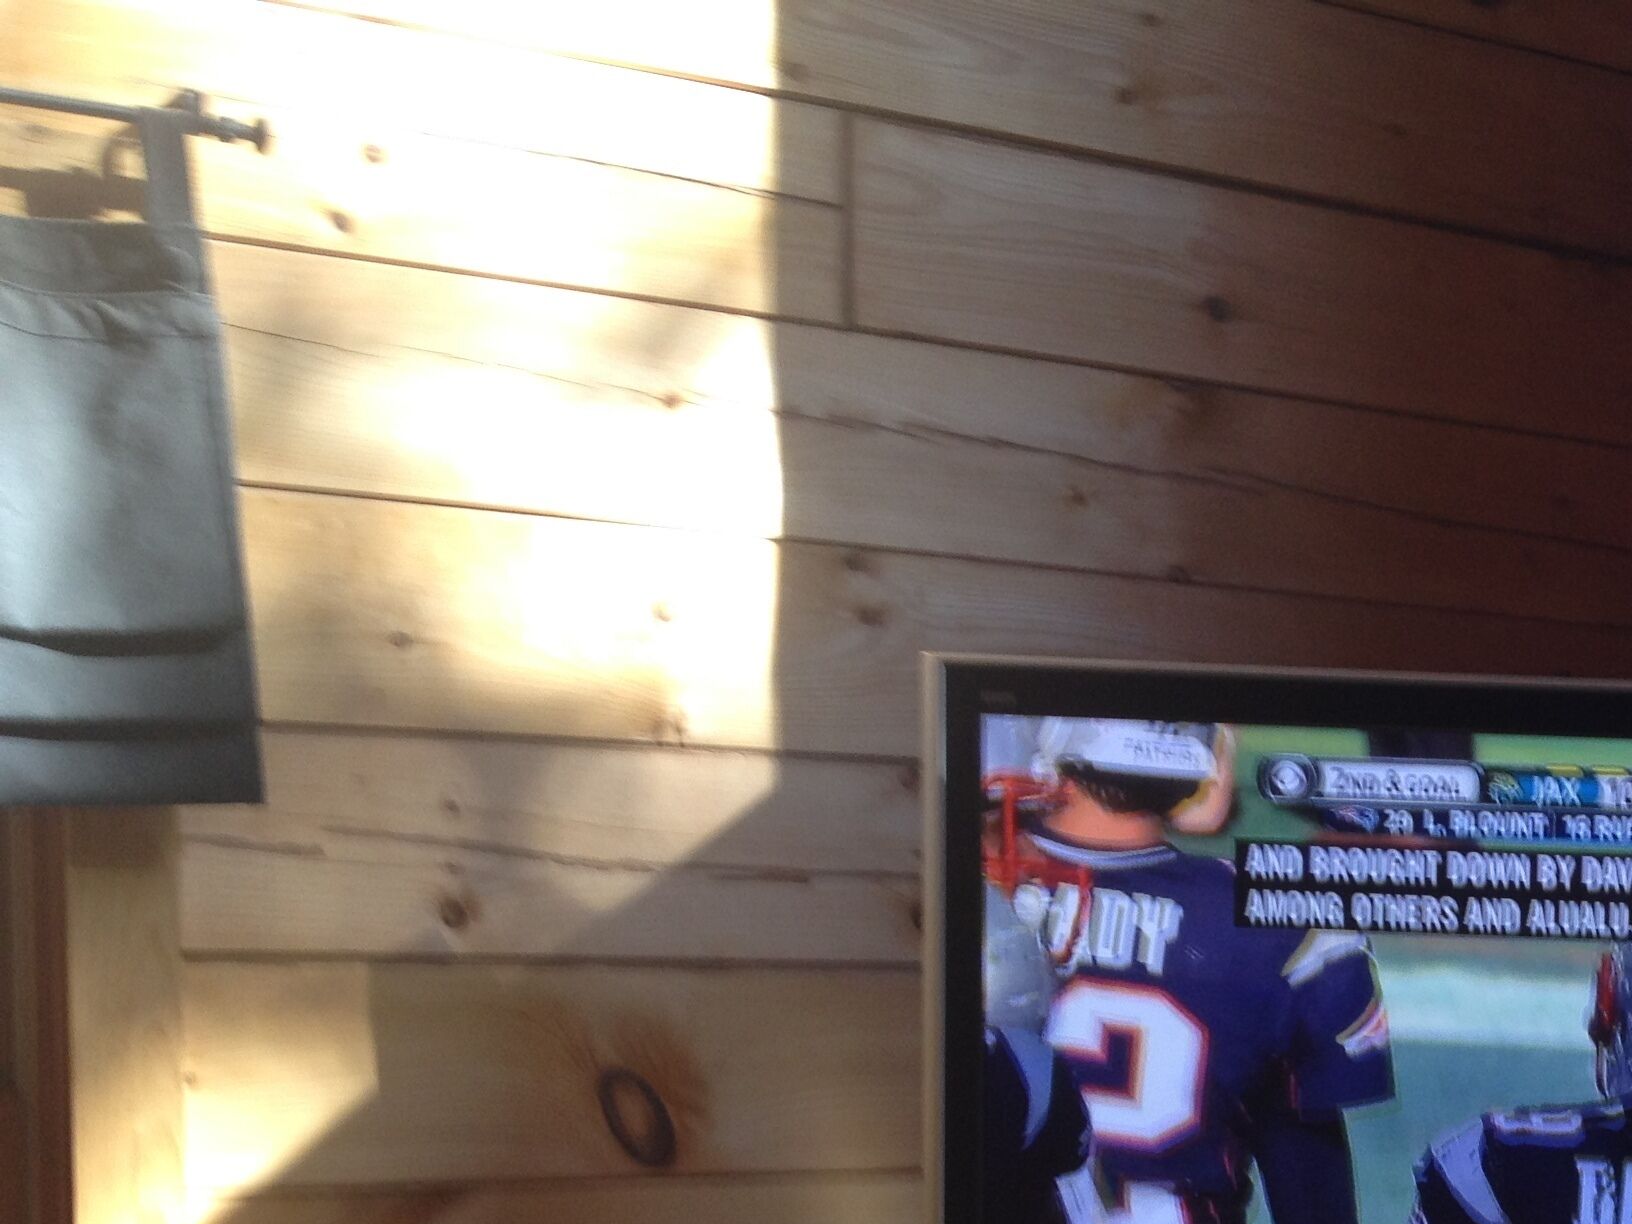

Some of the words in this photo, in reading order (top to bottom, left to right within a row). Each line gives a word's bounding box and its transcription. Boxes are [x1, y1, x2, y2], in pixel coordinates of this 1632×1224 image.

[1329, 765, 1381, 794] 2ND
[1530, 775, 1582, 808] JAX
[1449, 809, 1550, 841] BLOUNT
[1244, 843, 1304, 883] AND
[1308, 845, 1443, 888] BROUGHT
[1446, 850, 1531, 892] DOWN
[1536, 853, 1576, 893] BY
[1243, 888, 1345, 929] AMONG
[1350, 892, 1460, 933] OTHERS
[1462, 896, 1522, 937] AND
